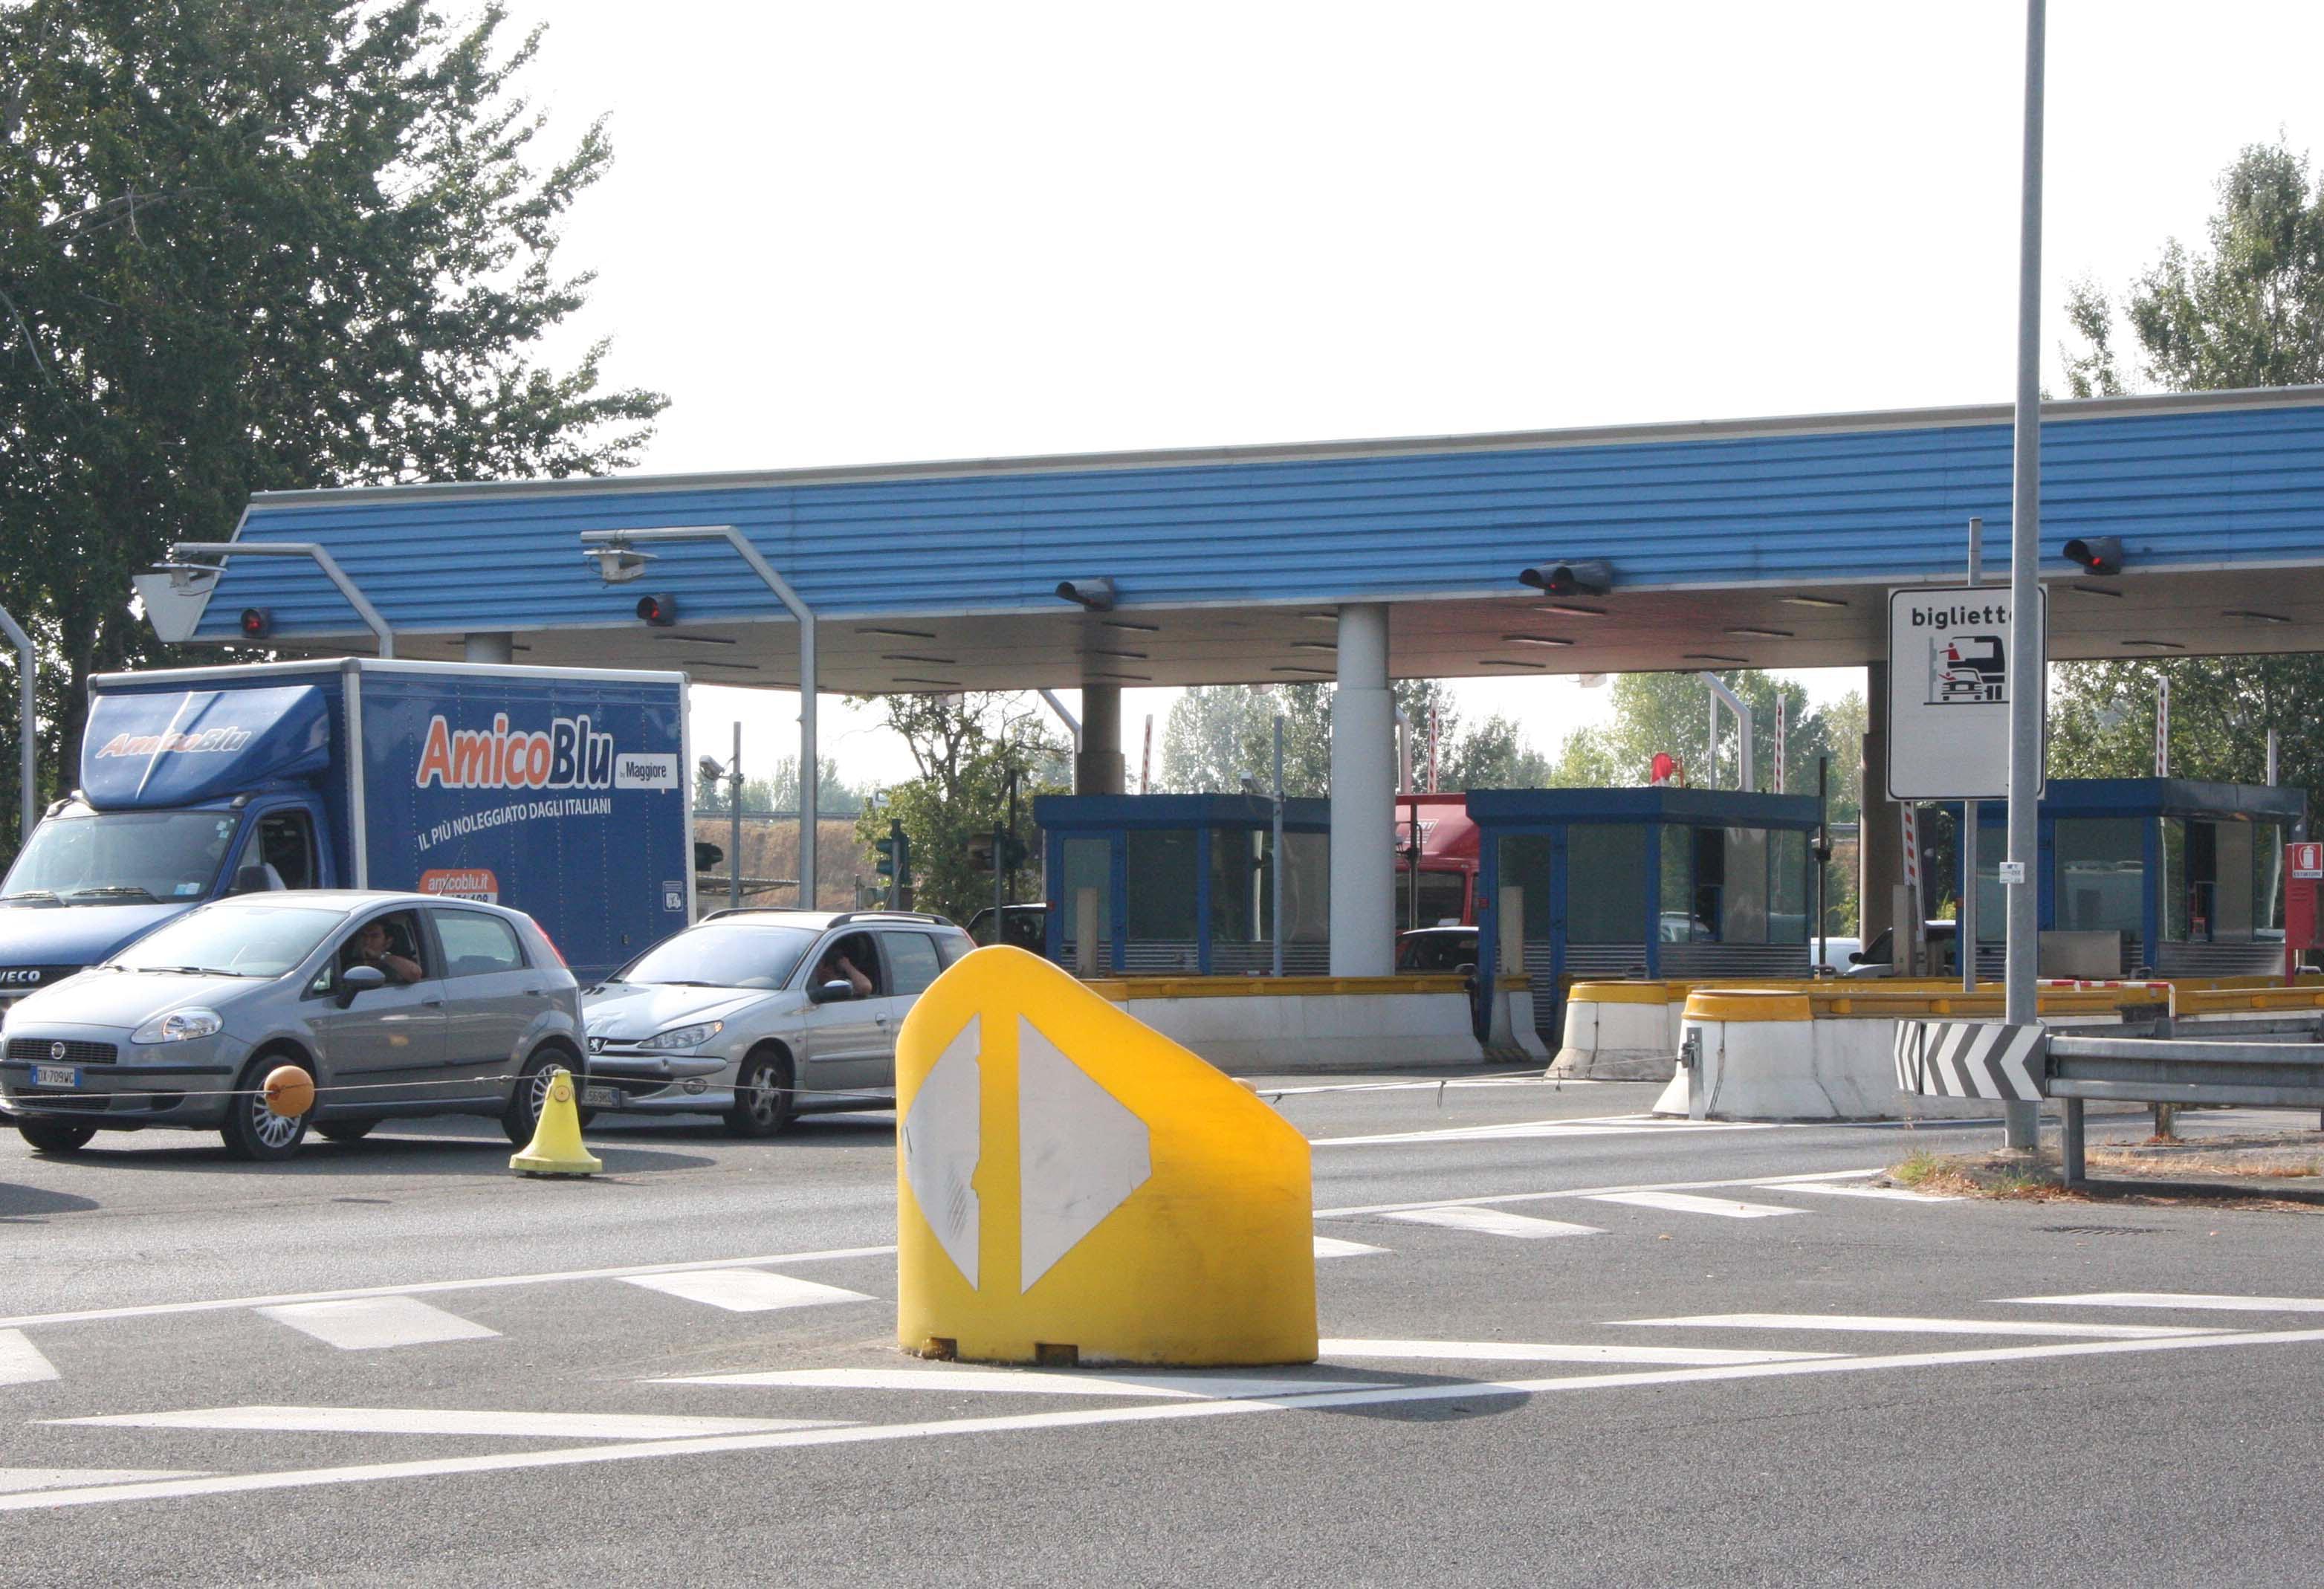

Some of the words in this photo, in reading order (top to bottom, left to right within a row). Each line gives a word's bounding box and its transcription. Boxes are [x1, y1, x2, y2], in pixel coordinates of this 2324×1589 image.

[1912, 606, 2012, 630] bigliett
[416, 713, 612, 789] AmicoBlu
[626, 762, 666, 781] Maggiore
[418, 835, 430, 851] IL
[431, 820, 450, 844] PIÙ
[453, 804, 527, 836] NOLEGGIATO
[529, 800, 563, 819] DAGLI
[566, 798, 611, 815] ITALIANI
[428, 873, 488, 890] amicoblu.it
